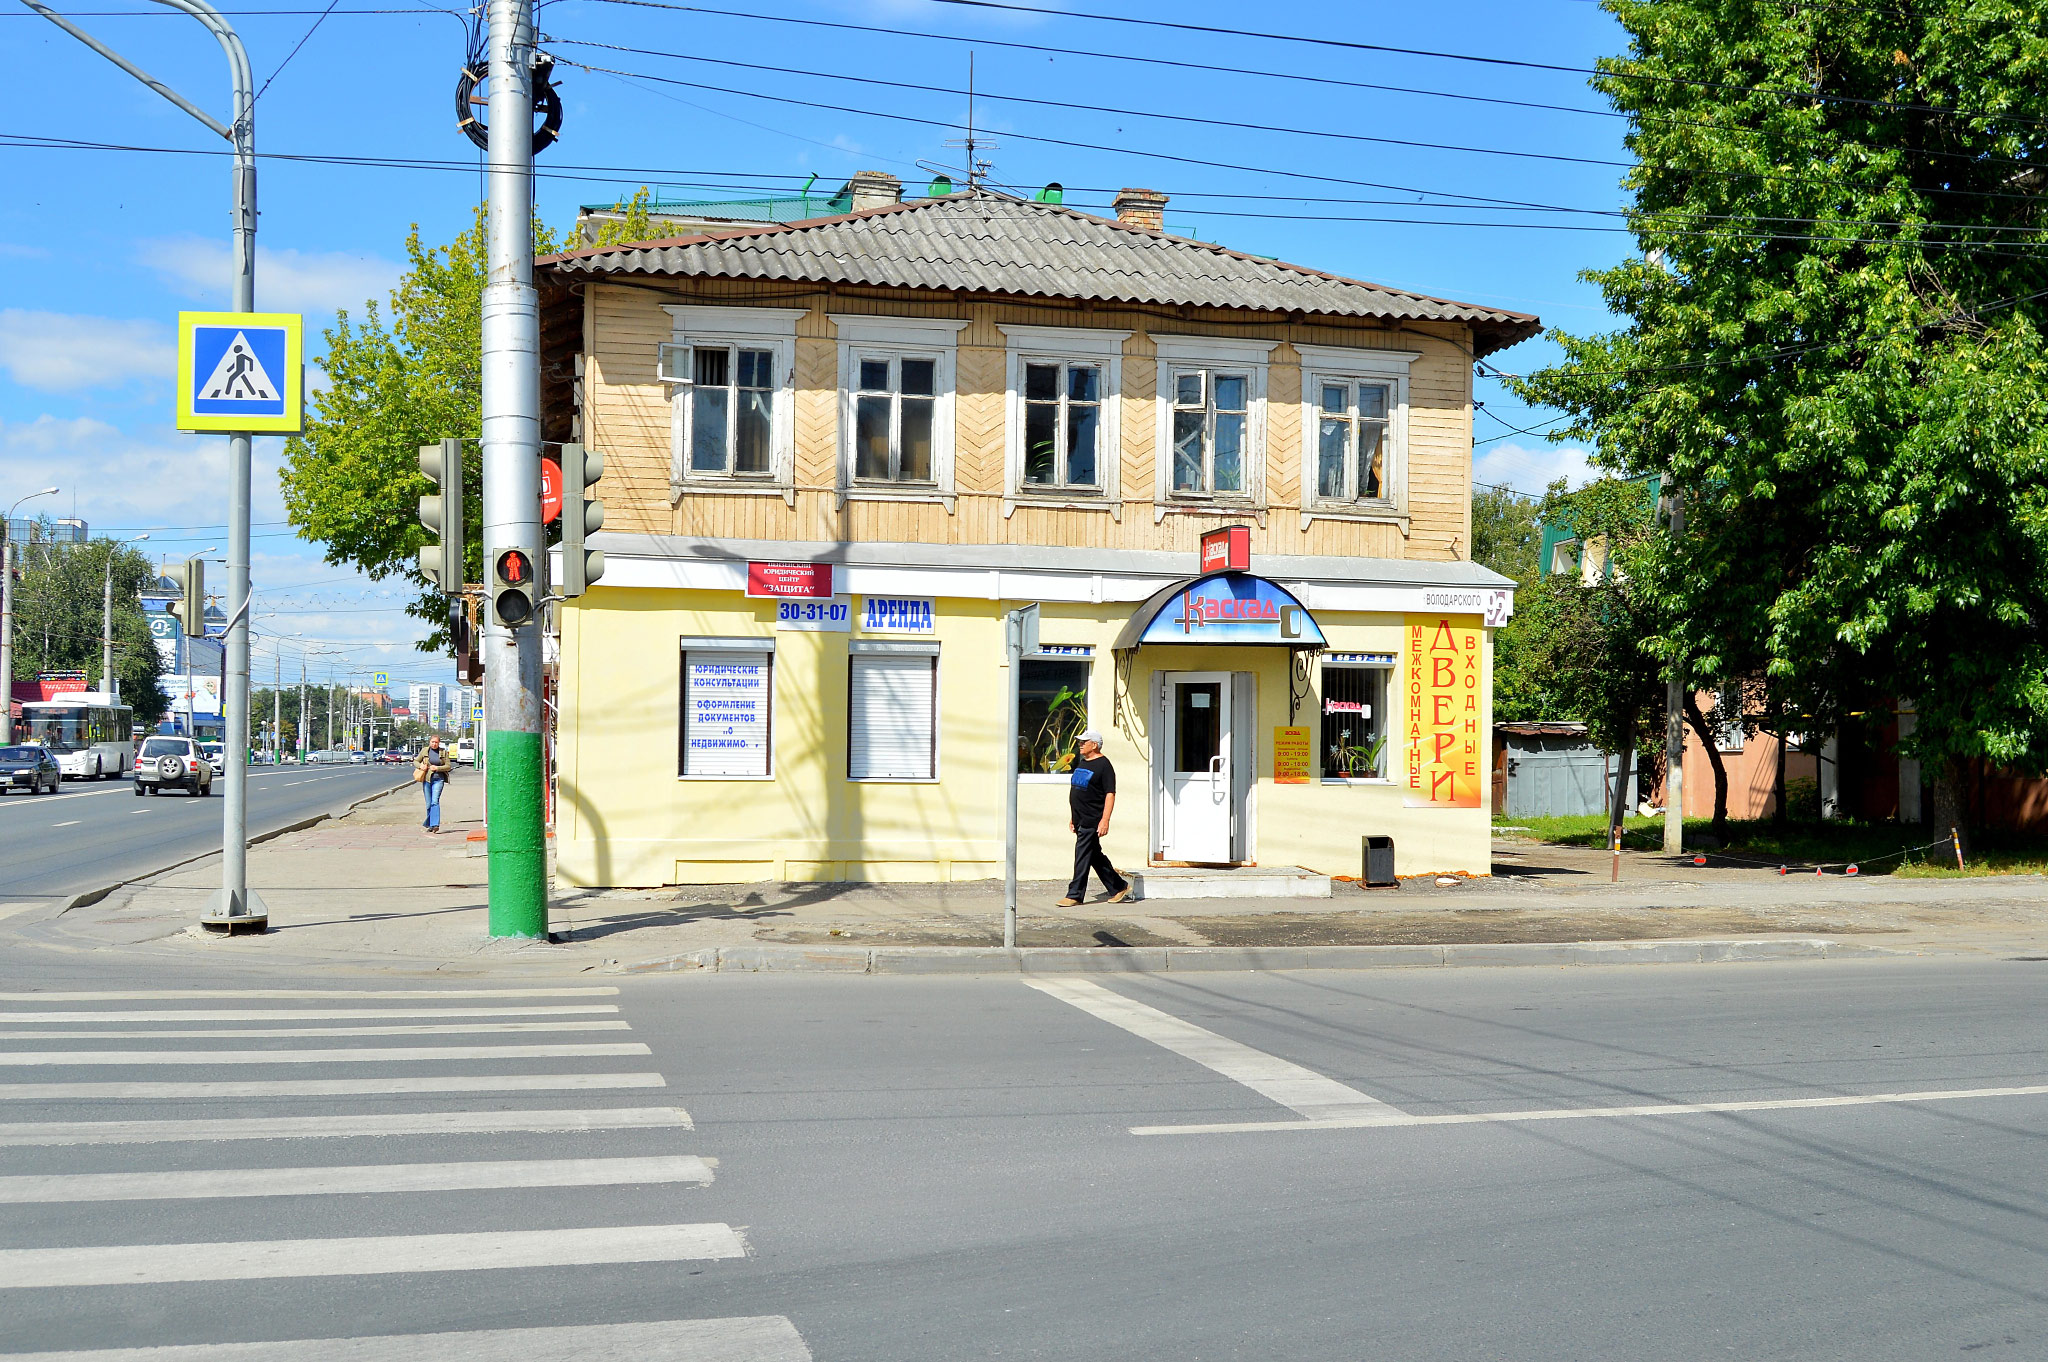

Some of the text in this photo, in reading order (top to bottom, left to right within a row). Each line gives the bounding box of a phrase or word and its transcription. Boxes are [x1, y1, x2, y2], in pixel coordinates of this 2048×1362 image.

[763, 568, 815, 577] ЮРИДИЧЕСКИЙ
[1425, 593, 1482, 608] ВОЛОДАРСКОГО
[1487, 591, 1506, 626] 92
[779, 602, 848, 621] 30-31-07
[866, 599, 932, 632] АРЕНДА
[695, 665, 759, 675] ЮРИДИЧЕСКИЕ
[694, 678, 760, 688] КОНСУЛЬТАЦИИ
[697, 700, 756, 710] ОФОРМЛЕНИЕ
[1410, 625, 1422, 788] МЕЖКОМНАТНЫЕ
[1429, 619, 1459, 802] ДВЕРИ
[1464, 636, 1476, 776] ВХОДНЫЕ
[698, 713, 756, 723] ДОКУМЕНТОВ
